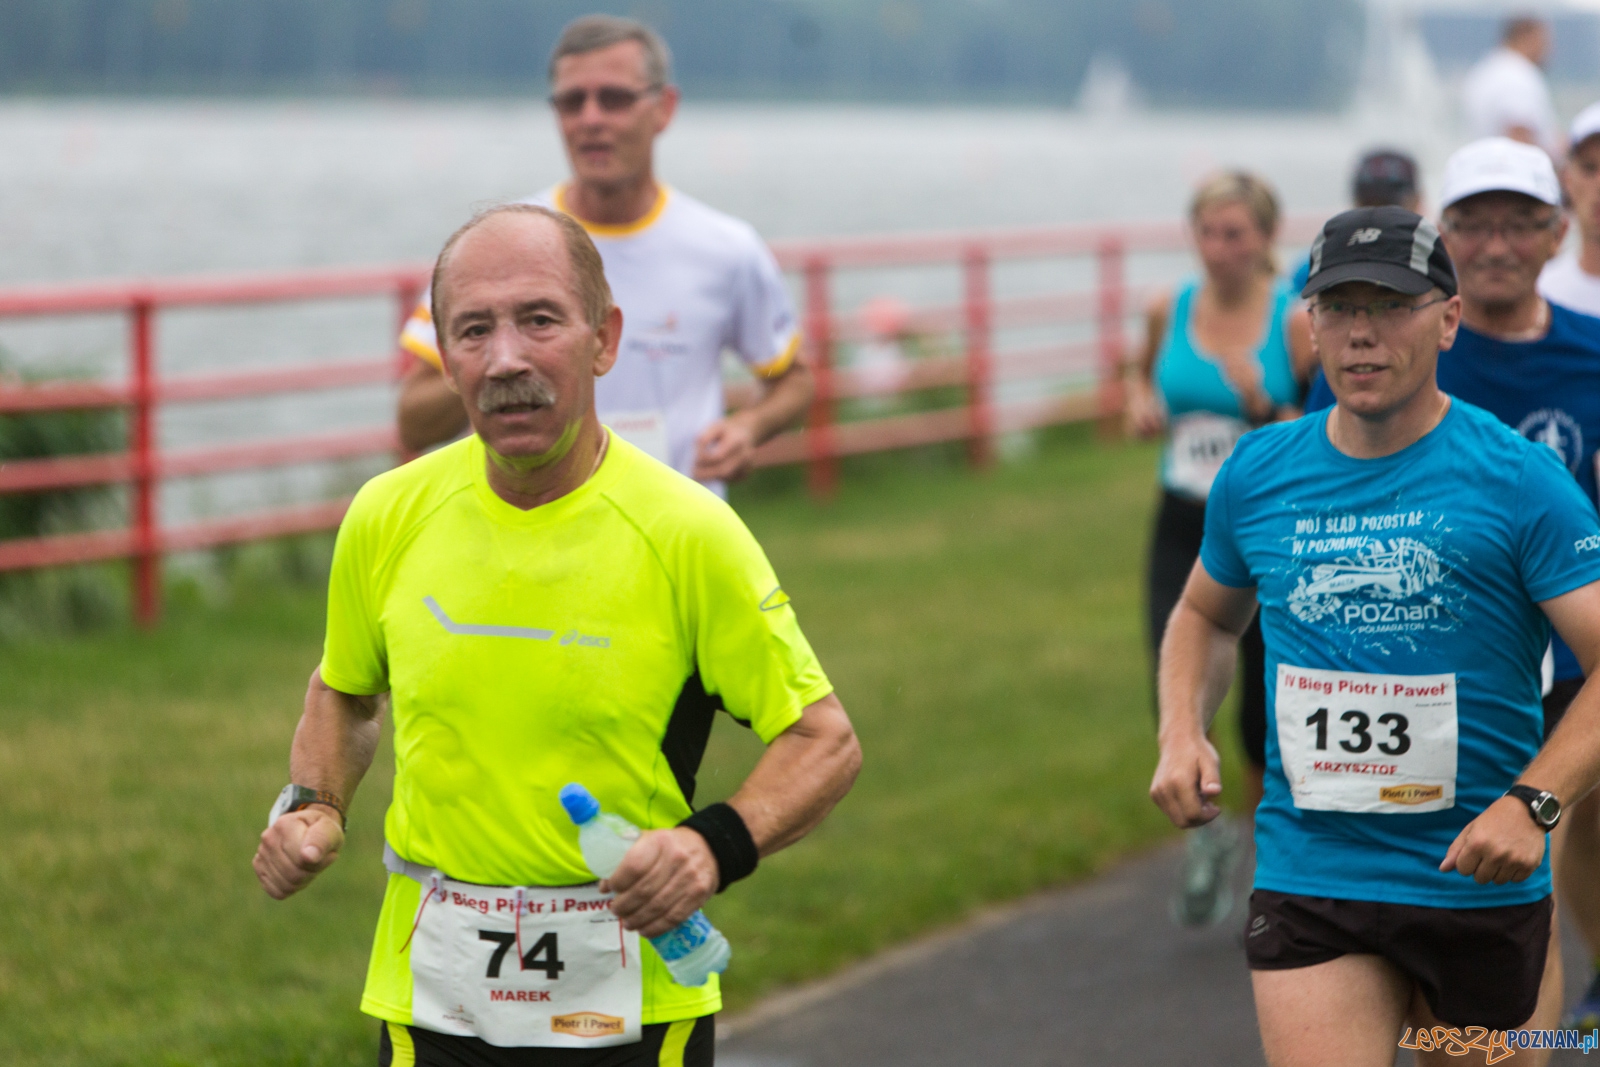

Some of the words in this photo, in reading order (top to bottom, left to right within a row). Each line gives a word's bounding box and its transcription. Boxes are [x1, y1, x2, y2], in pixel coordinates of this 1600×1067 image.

[1292, 539, 1306, 555] W
[1574, 535, 1600, 554] POZ
[1298, 677, 1333, 695] Bieg
[1338, 680, 1378, 695] Piotr
[1383, 683, 1387, 696] i
[1393, 683, 1446, 697] Paweł
[1305, 707, 1411, 755] 133
[1313, 760, 1399, 775] KRZYSZTOF
[1382, 788, 1405, 798] Piotr
[452, 892, 489, 914] Bieg
[551, 899, 556, 913] i
[478, 929, 565, 980] 74
[490, 990, 552, 1002] MAREK
[554, 1017, 581, 1028] Piotr
